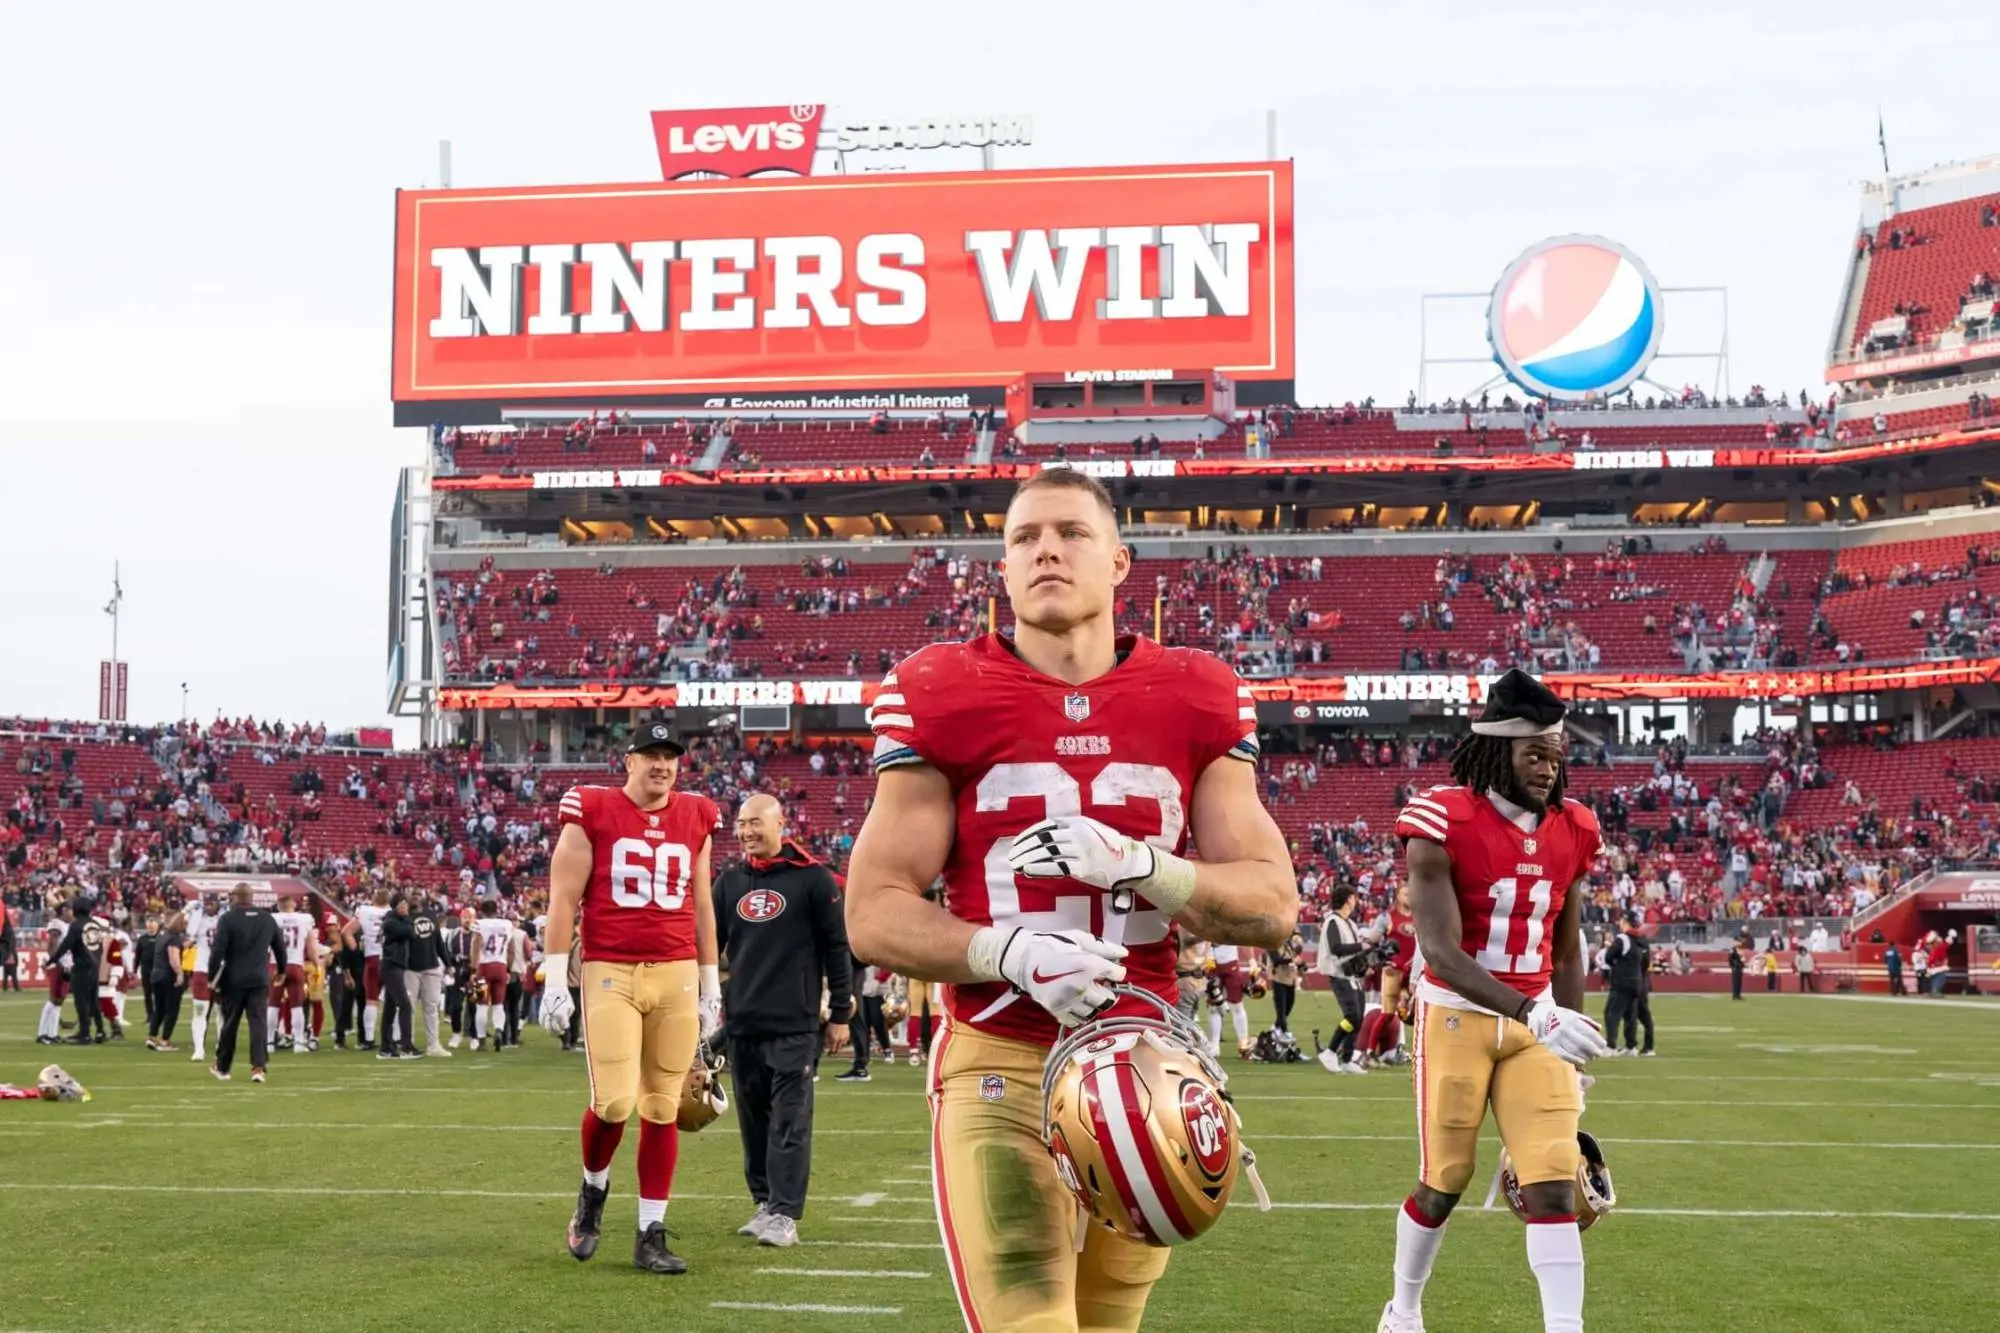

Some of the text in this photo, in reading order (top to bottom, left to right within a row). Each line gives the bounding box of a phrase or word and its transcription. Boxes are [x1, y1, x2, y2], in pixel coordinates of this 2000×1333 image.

[429, 223, 1260, 338] NINERS WIN
[811, 395, 896, 408] Industrial
[899, 392, 970, 408] Internet
[676, 681, 863, 707] NINERS WIN
[1344, 675, 1471, 701] NINERS
[1316, 706, 1369, 718] TOYOTA
[1054, 736, 1111, 756] 49ERS
[611, 837, 692, 910] 60
[1476, 877, 1552, 974] 11
[485, 934, 508, 954] 47
